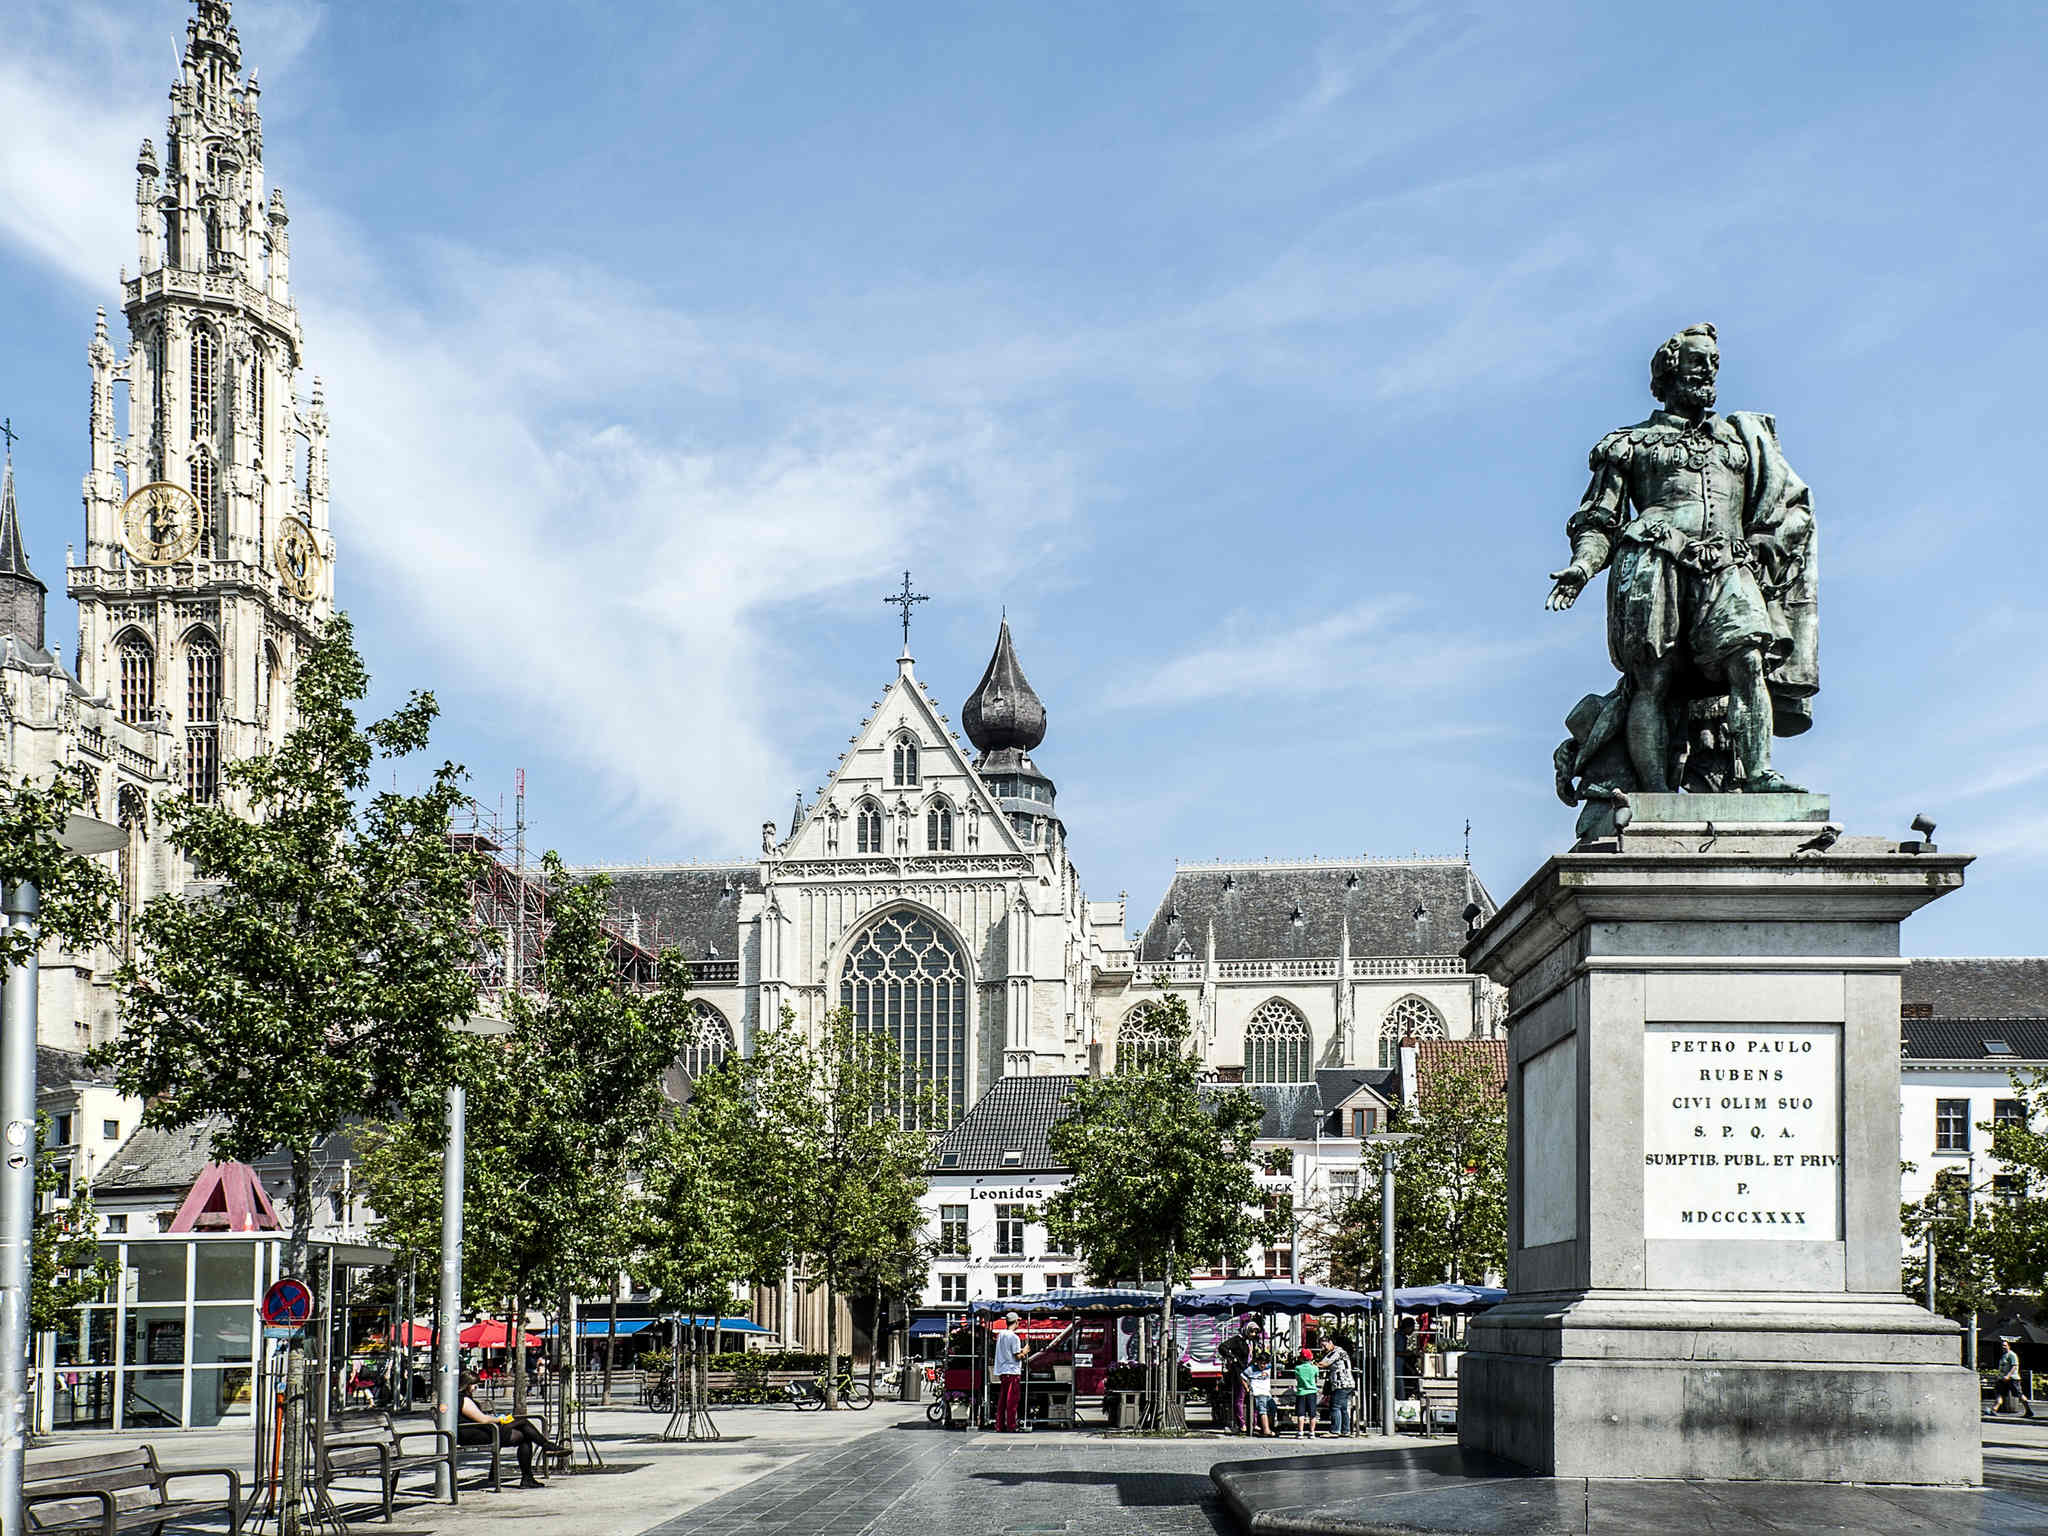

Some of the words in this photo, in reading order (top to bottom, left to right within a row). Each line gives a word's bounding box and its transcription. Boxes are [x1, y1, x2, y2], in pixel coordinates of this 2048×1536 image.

[1671, 1040, 1735, 1053] PETRO
[1747, 1040, 1812, 1053] PAULO
[1699, 1069, 1784, 1081] RUBENS
[1672, 1097, 1711, 1109] CIVI
[1720, 1097, 1767, 1109] OLIM
[1778, 1097, 1813, 1110] SUO
[1694, 1125, 1707, 1138] S.
[1722, 1125, 1734, 1138] P.
[1750, 1126, 1765, 1139] Q.
[1779, 1127, 1795, 1138] A.
[1645, 1153, 1719, 1166] SUMPTIB.
[1724, 1154, 1770, 1166] PUBL.
[1773, 1154, 1794, 1166] ET
[1800, 1154, 1841, 1167] PRIV.
[970, 1186, 1043, 1200] Leonidas
[1737, 1182, 1750, 1195] P.
[1681, 1210, 1806, 1224] MDCCCXXXX
